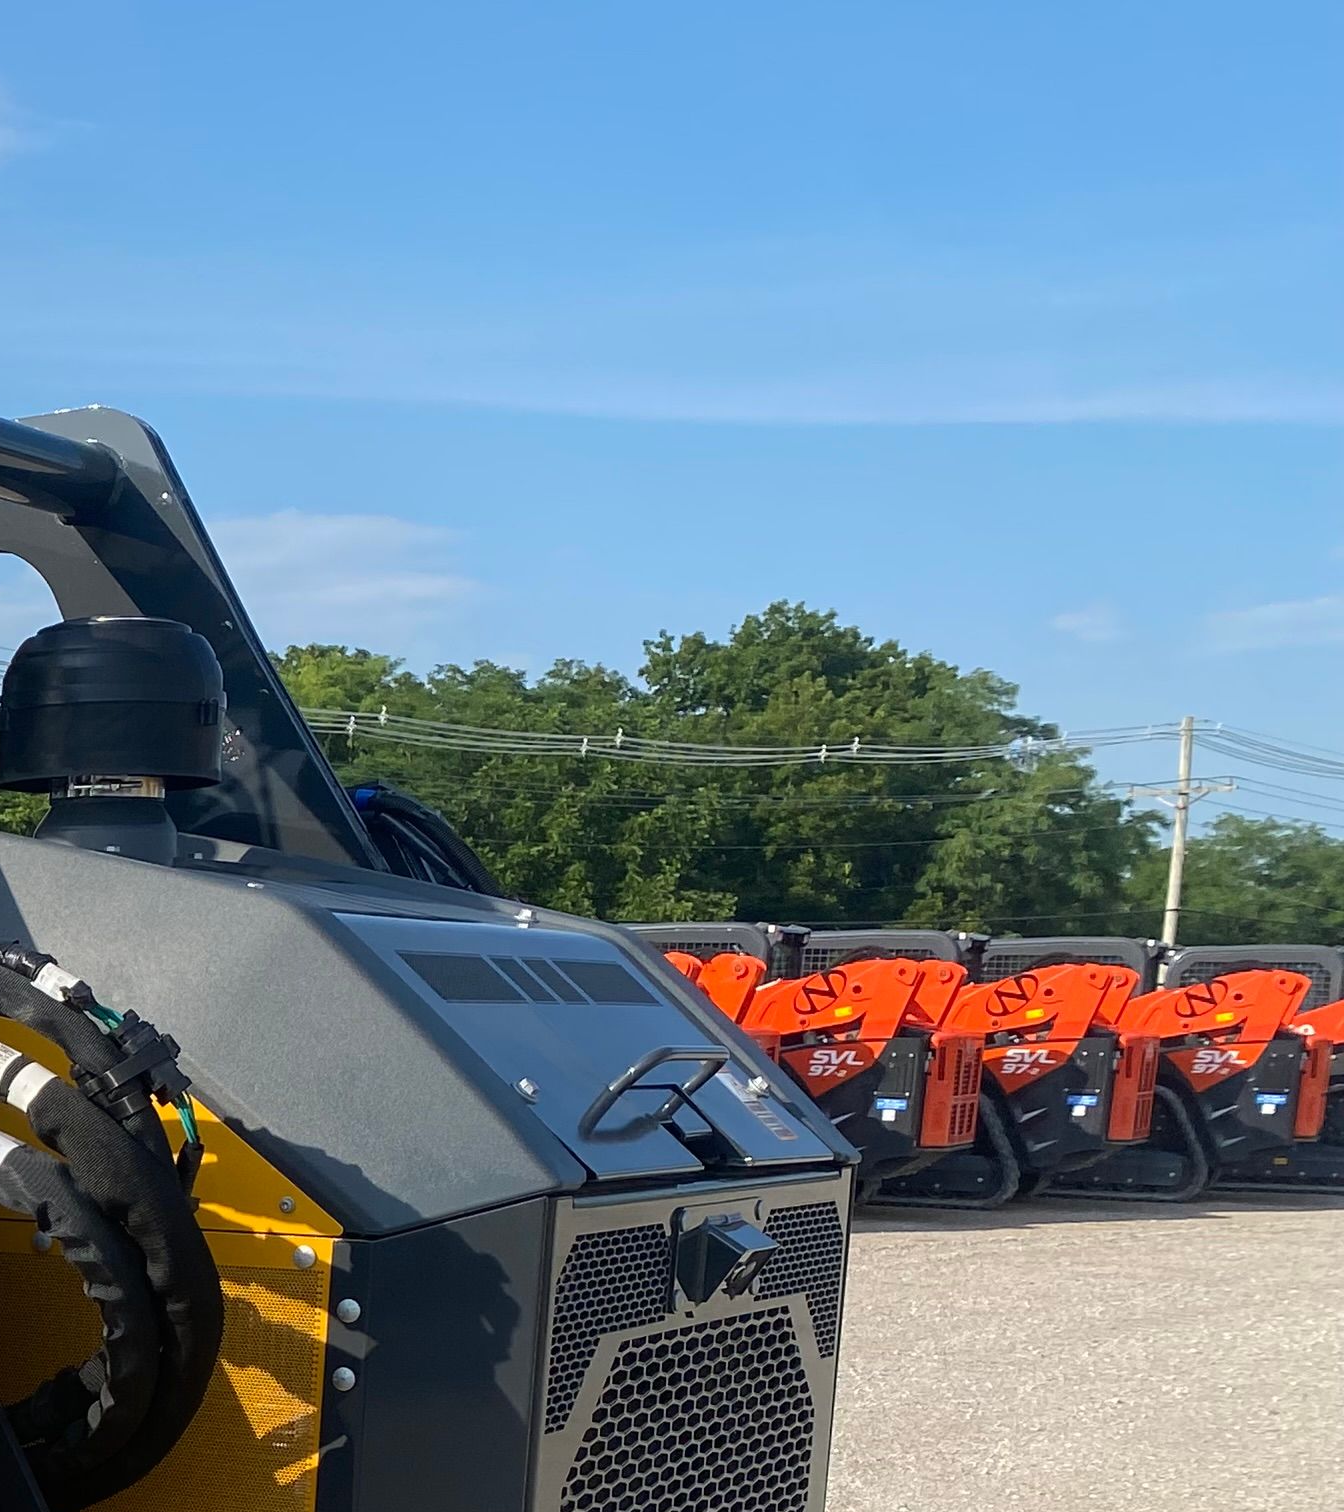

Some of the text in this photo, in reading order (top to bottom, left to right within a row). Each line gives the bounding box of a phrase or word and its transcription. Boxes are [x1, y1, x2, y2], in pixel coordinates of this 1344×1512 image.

[808, 1050, 864, 1065] SVL
[1002, 1049, 1057, 1064] SVL
[1192, 1050, 1248, 1065] SVL
